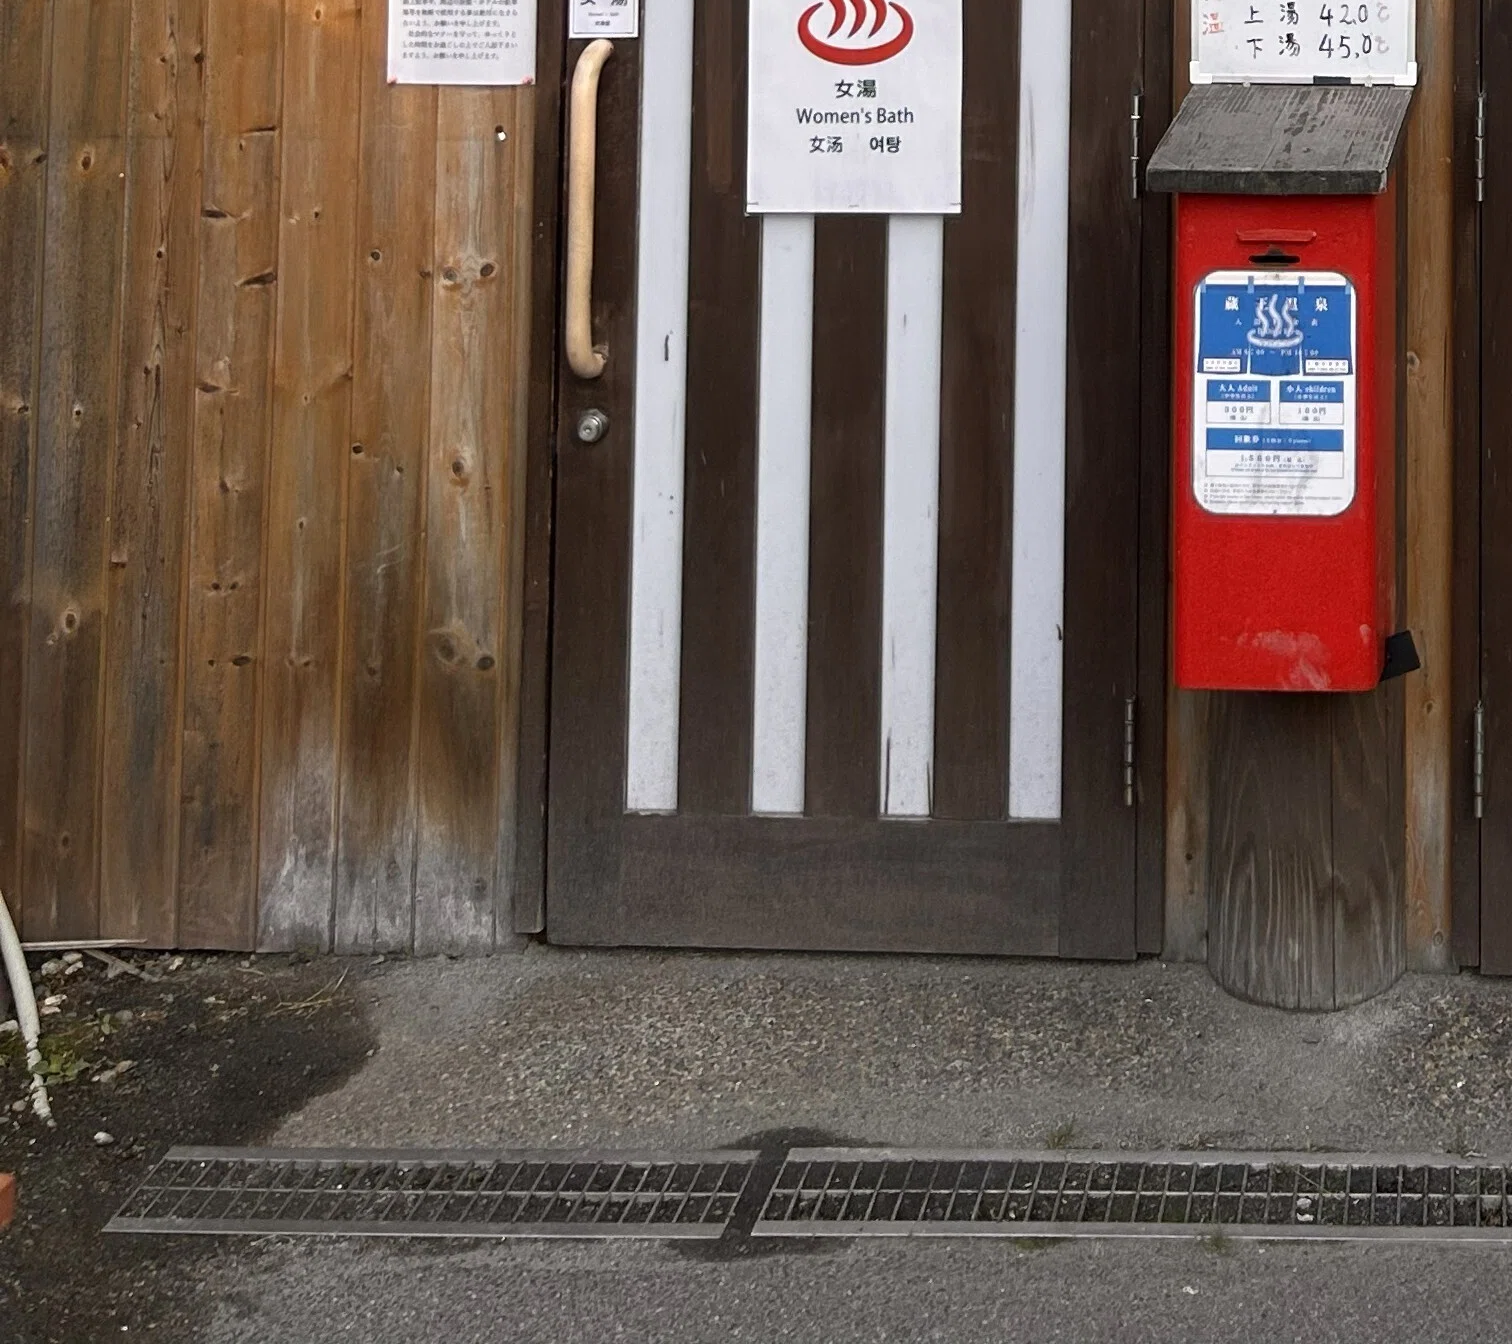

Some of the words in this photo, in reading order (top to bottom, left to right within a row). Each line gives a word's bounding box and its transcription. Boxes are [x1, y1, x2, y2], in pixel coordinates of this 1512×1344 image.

[835, 78, 877, 99] 女湯
[796, 108, 873, 125] Women's
[876, 108, 914, 125] Bath
[809, 135, 844, 154] 女汤
[869, 135, 902, 154] 여탕
